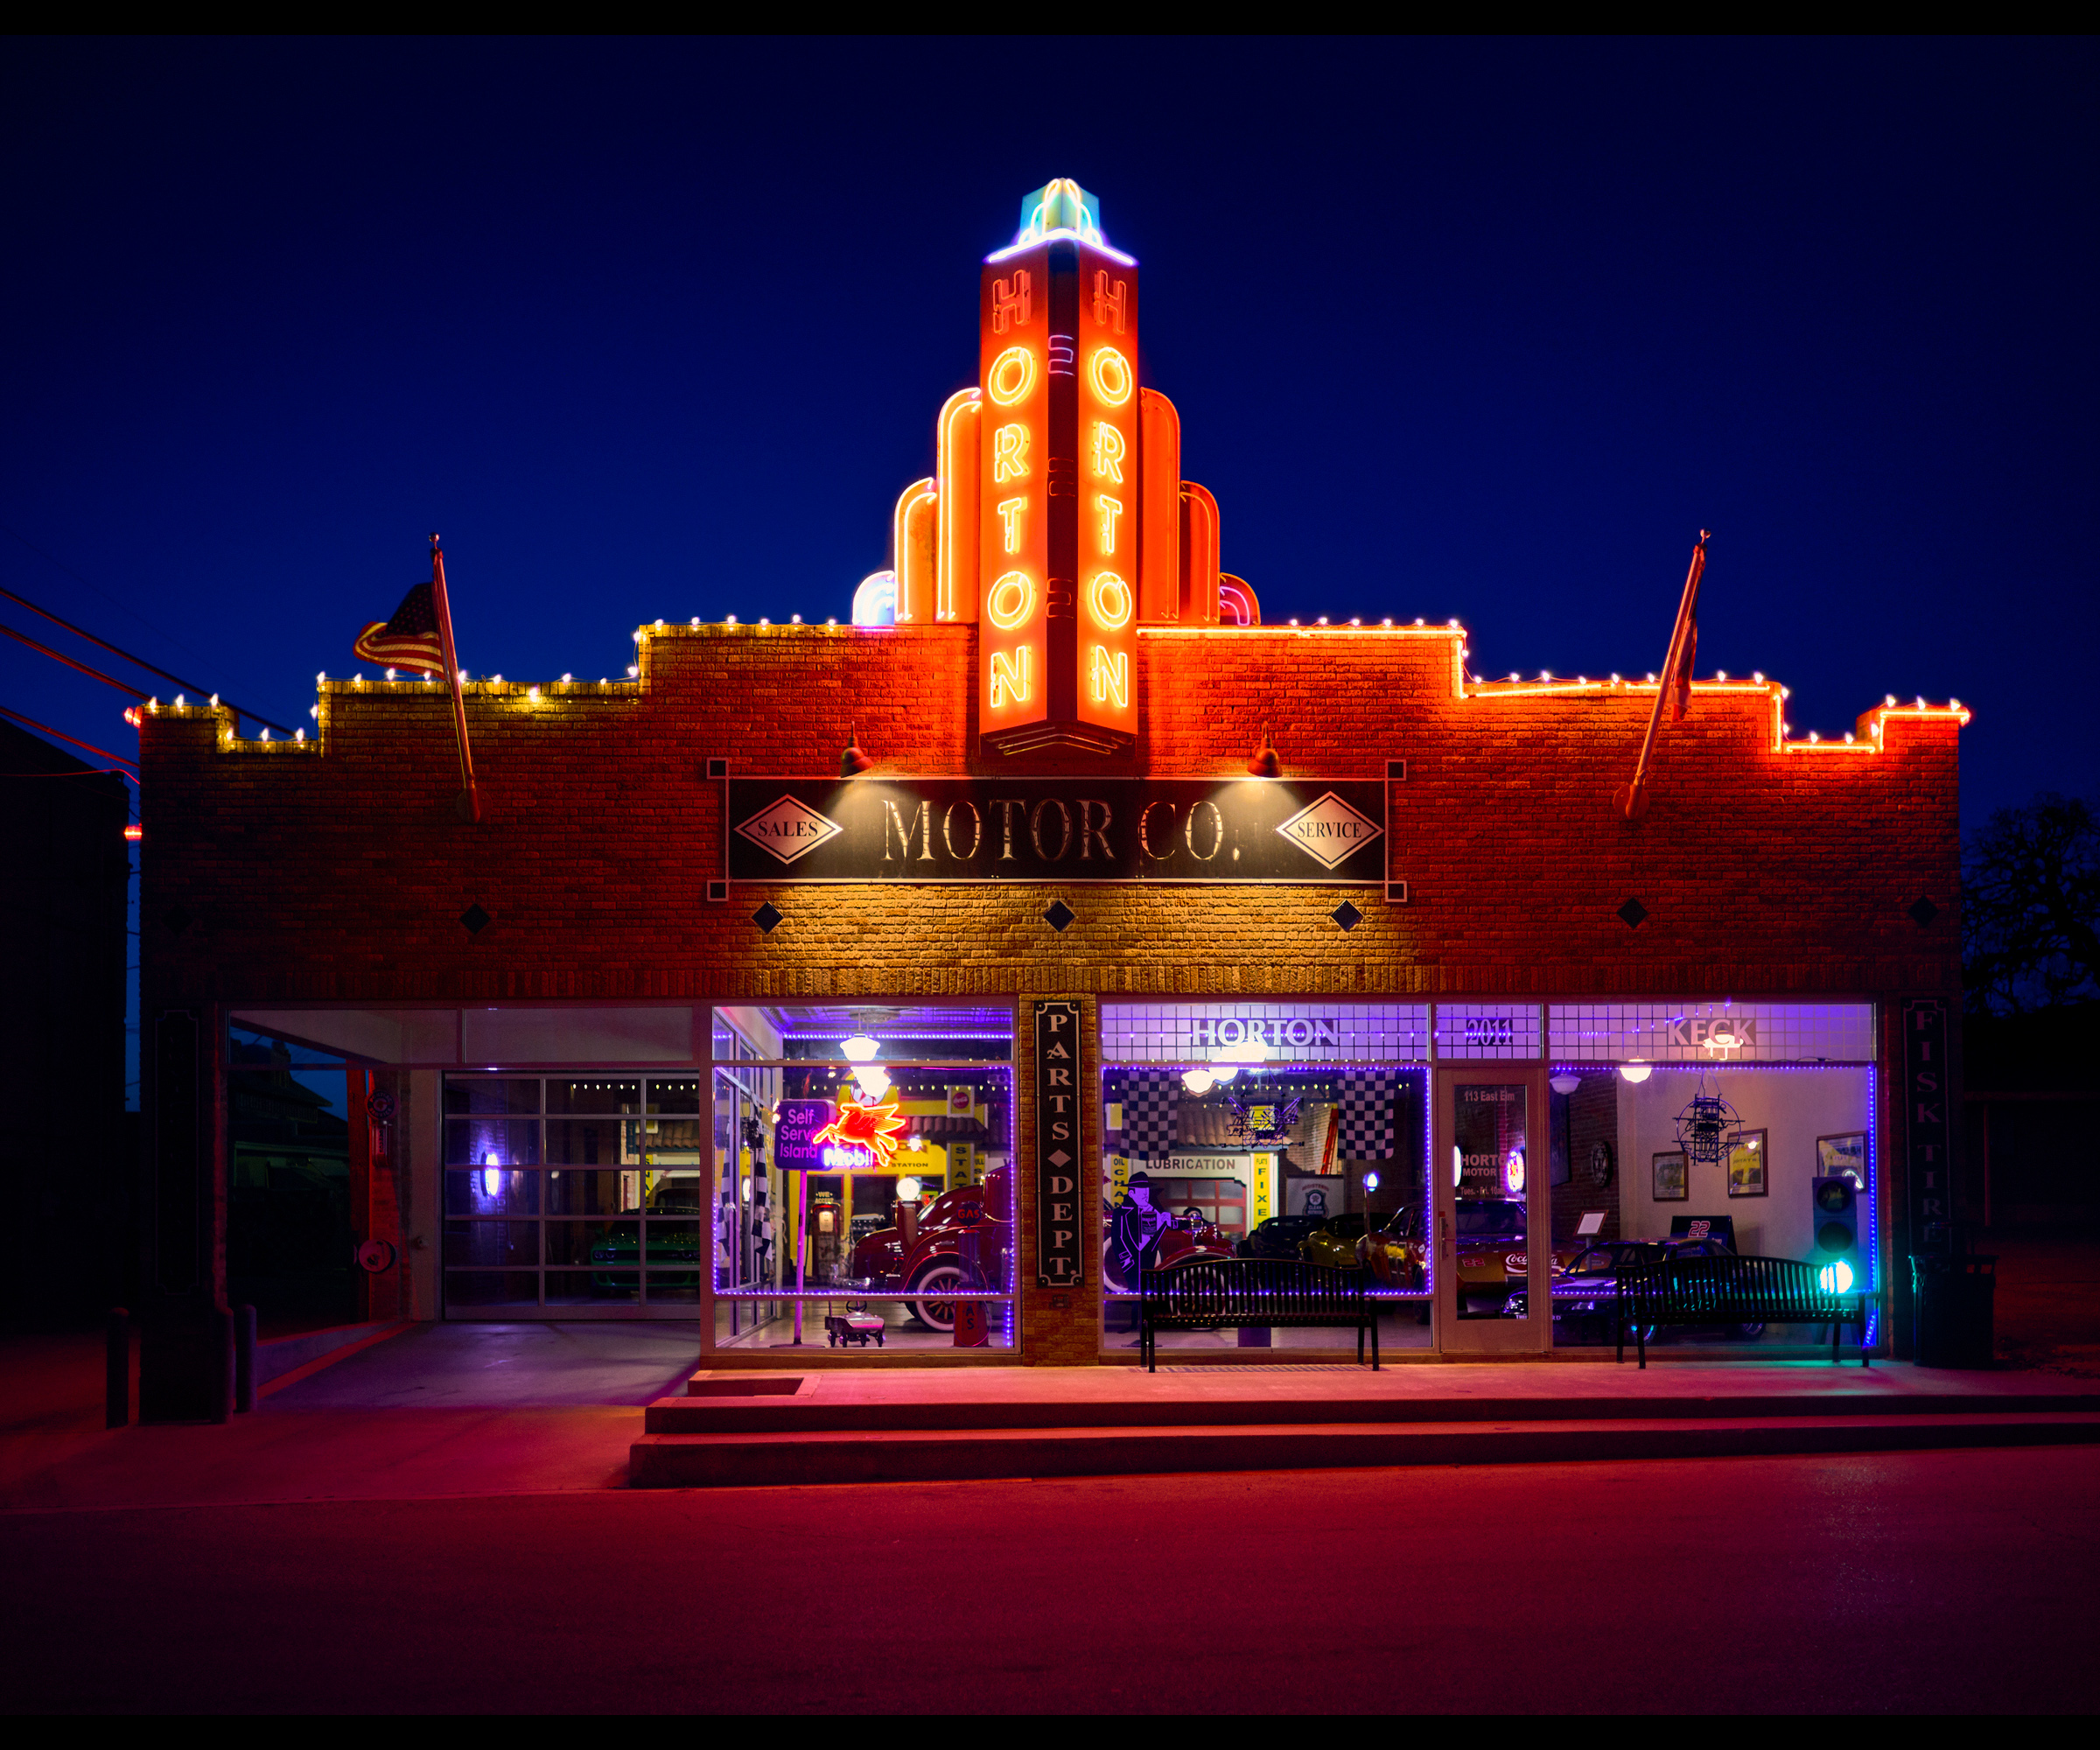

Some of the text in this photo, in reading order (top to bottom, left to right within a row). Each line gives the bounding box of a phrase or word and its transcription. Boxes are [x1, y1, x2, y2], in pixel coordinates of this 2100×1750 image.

[988, 270, 1037, 709] HORTON
[1086, 270, 1133, 709] HORTON
[758, 820, 819, 837] SALES
[880, 798, 1242, 862] MOTOR CO.
[1297, 821, 1362, 838] SERVICE
[1192, 1018, 1340, 1047] HORTON
[1466, 1018, 1513, 1046] 2011
[1668, 1018, 1755, 1046] KECK
[1464, 1090, 1516, 1102] 113 East Elm
[788, 1109, 814, 1124] Self
[780, 1125, 819, 1141] Serve
[1915, 1010, 1945, 1269] FISK TIRE
[780, 1143, 818, 1158] Island
[1046, 1014, 1077, 1277] PARTS DEPT.
[823, 1148, 873, 1166] Mobil
[1113, 1158, 1125, 1166] OIL
[1145, 1158, 1236, 1170] LUBRICATION
[1460, 1154, 1510, 1166] HORTO
[1463, 1168, 1497, 1177] MOTOR
[1257, 1168, 1268, 1226] FIXE
[957, 1208, 980, 1219] GAS
[1687, 1221, 1711, 1238] 22
[965, 1300, 975, 1330] AS
